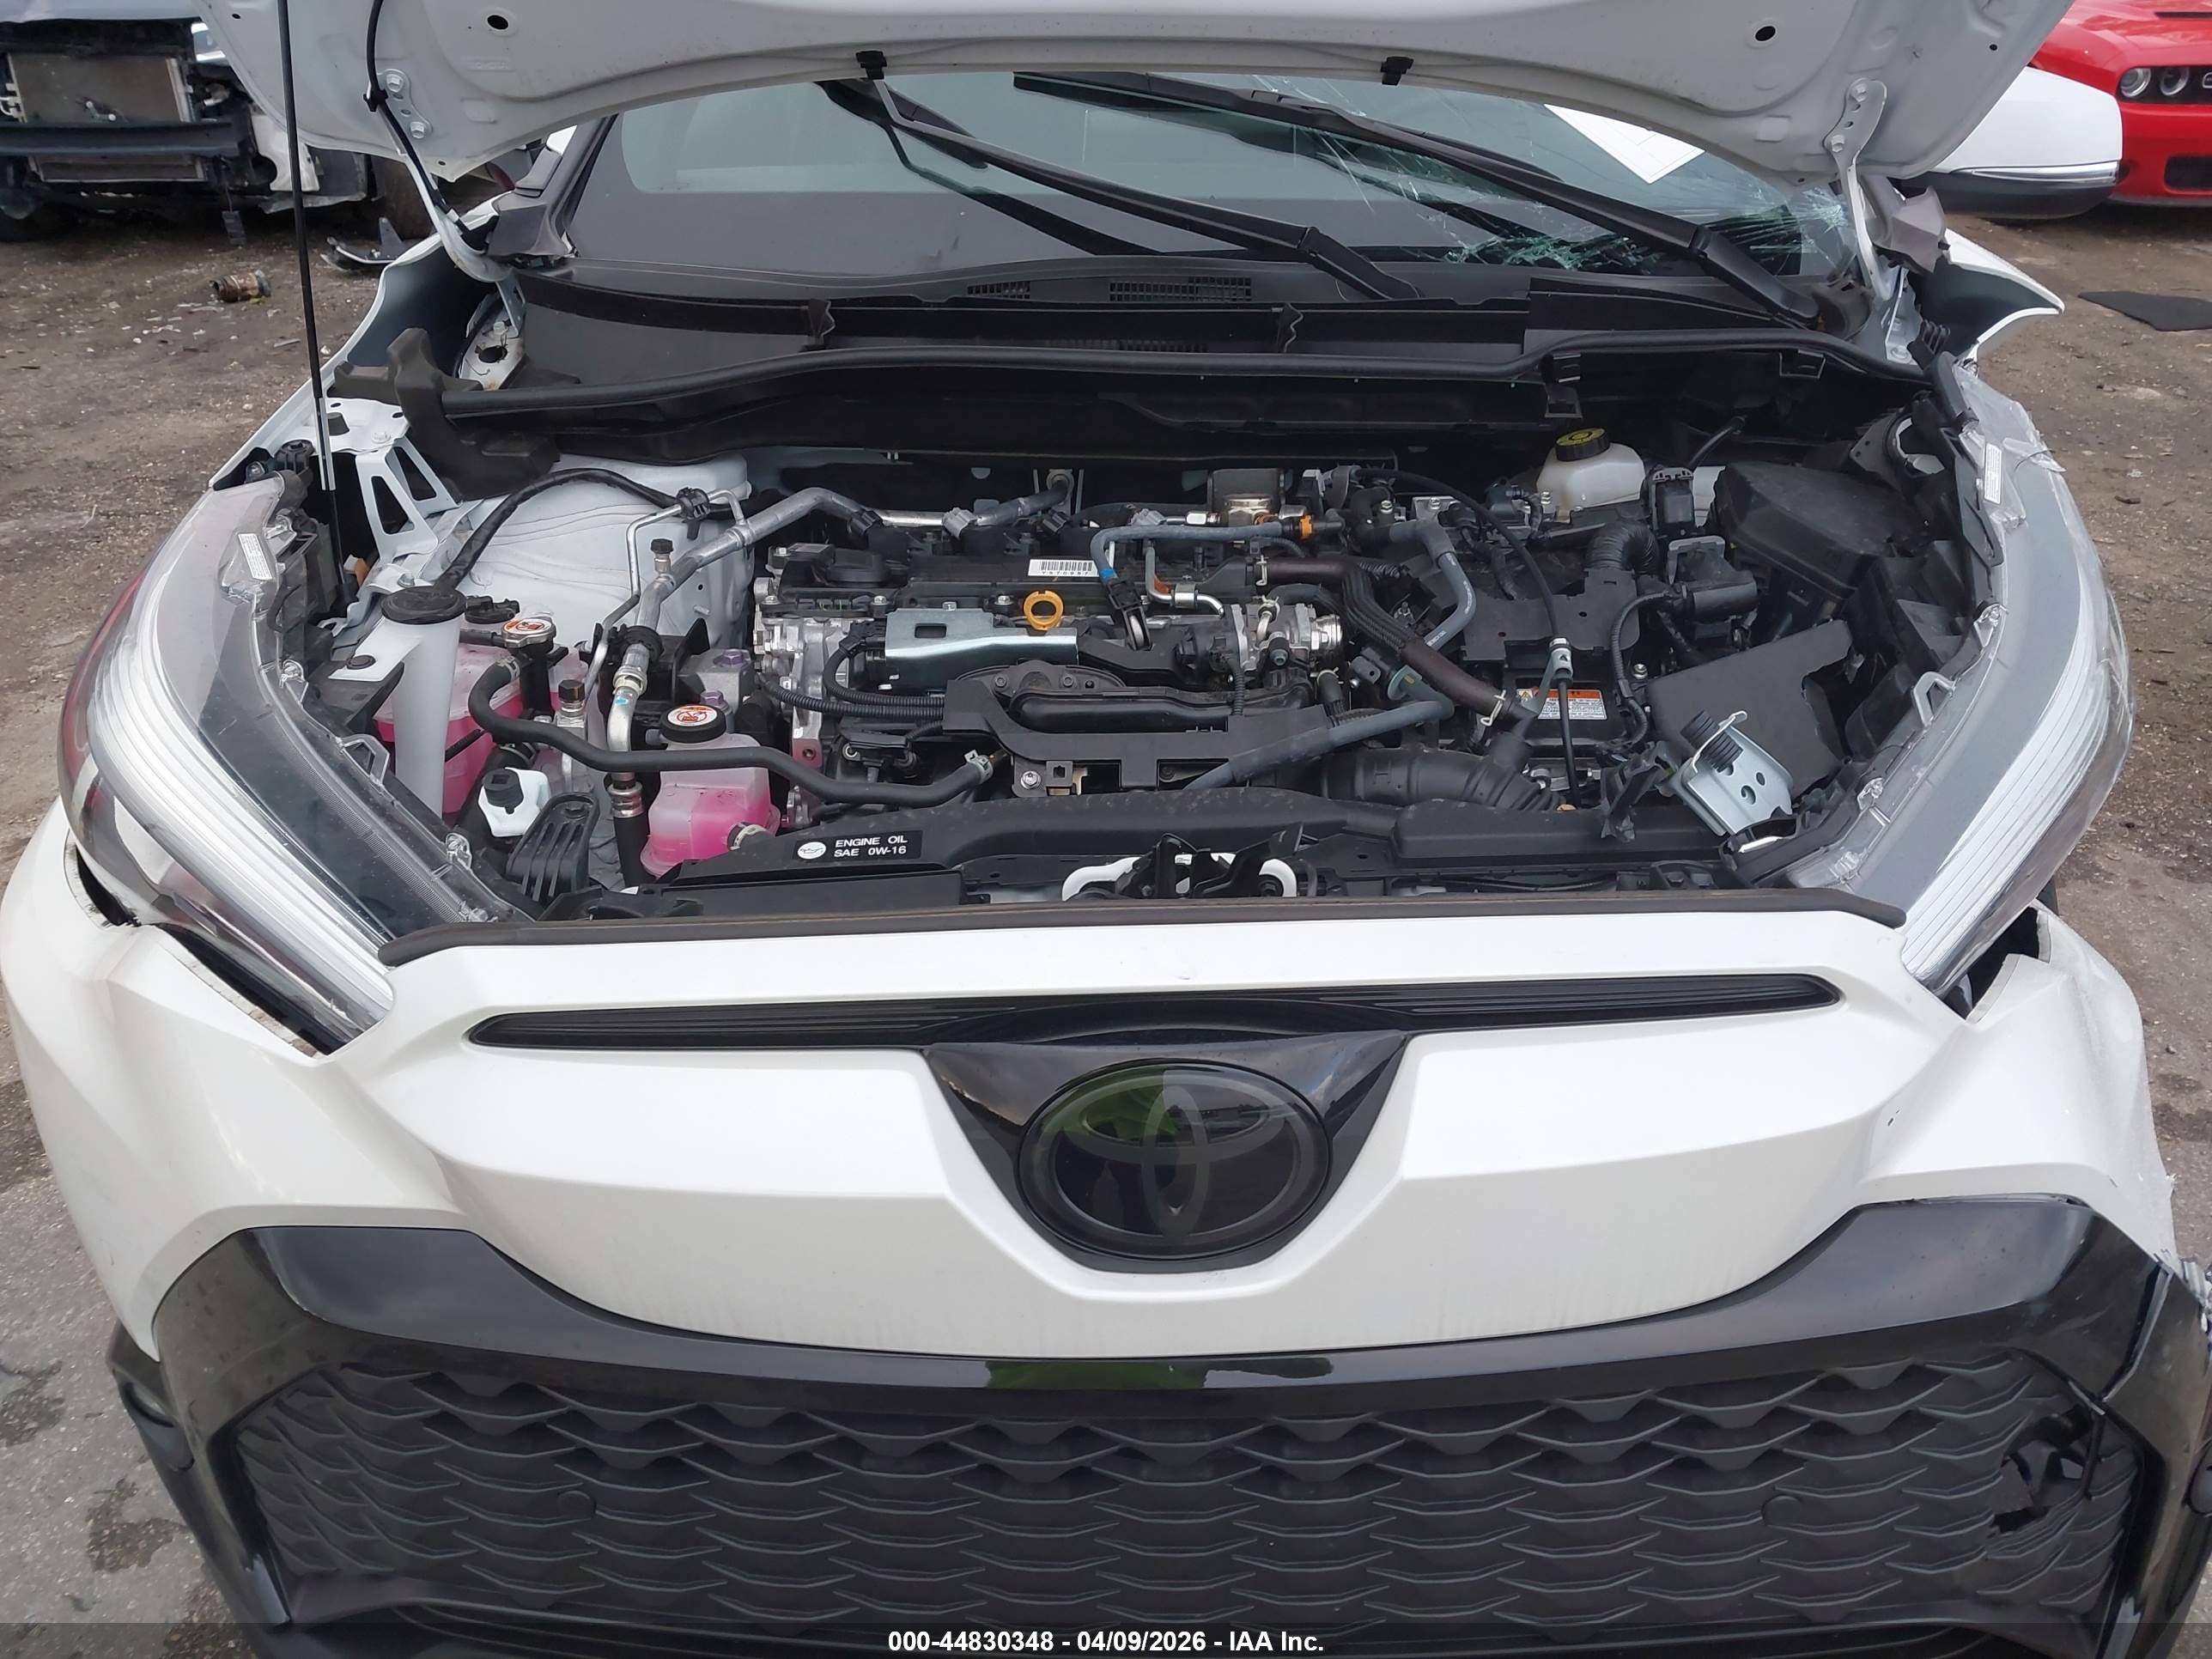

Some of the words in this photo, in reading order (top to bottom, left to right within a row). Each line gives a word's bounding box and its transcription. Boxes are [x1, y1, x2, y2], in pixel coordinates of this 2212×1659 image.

[835, 837, 880, 848] ENGINE
[887, 836, 908, 844] OIL
[834, 848, 859, 857] SAE
[867, 846, 907, 855] 0W-16
